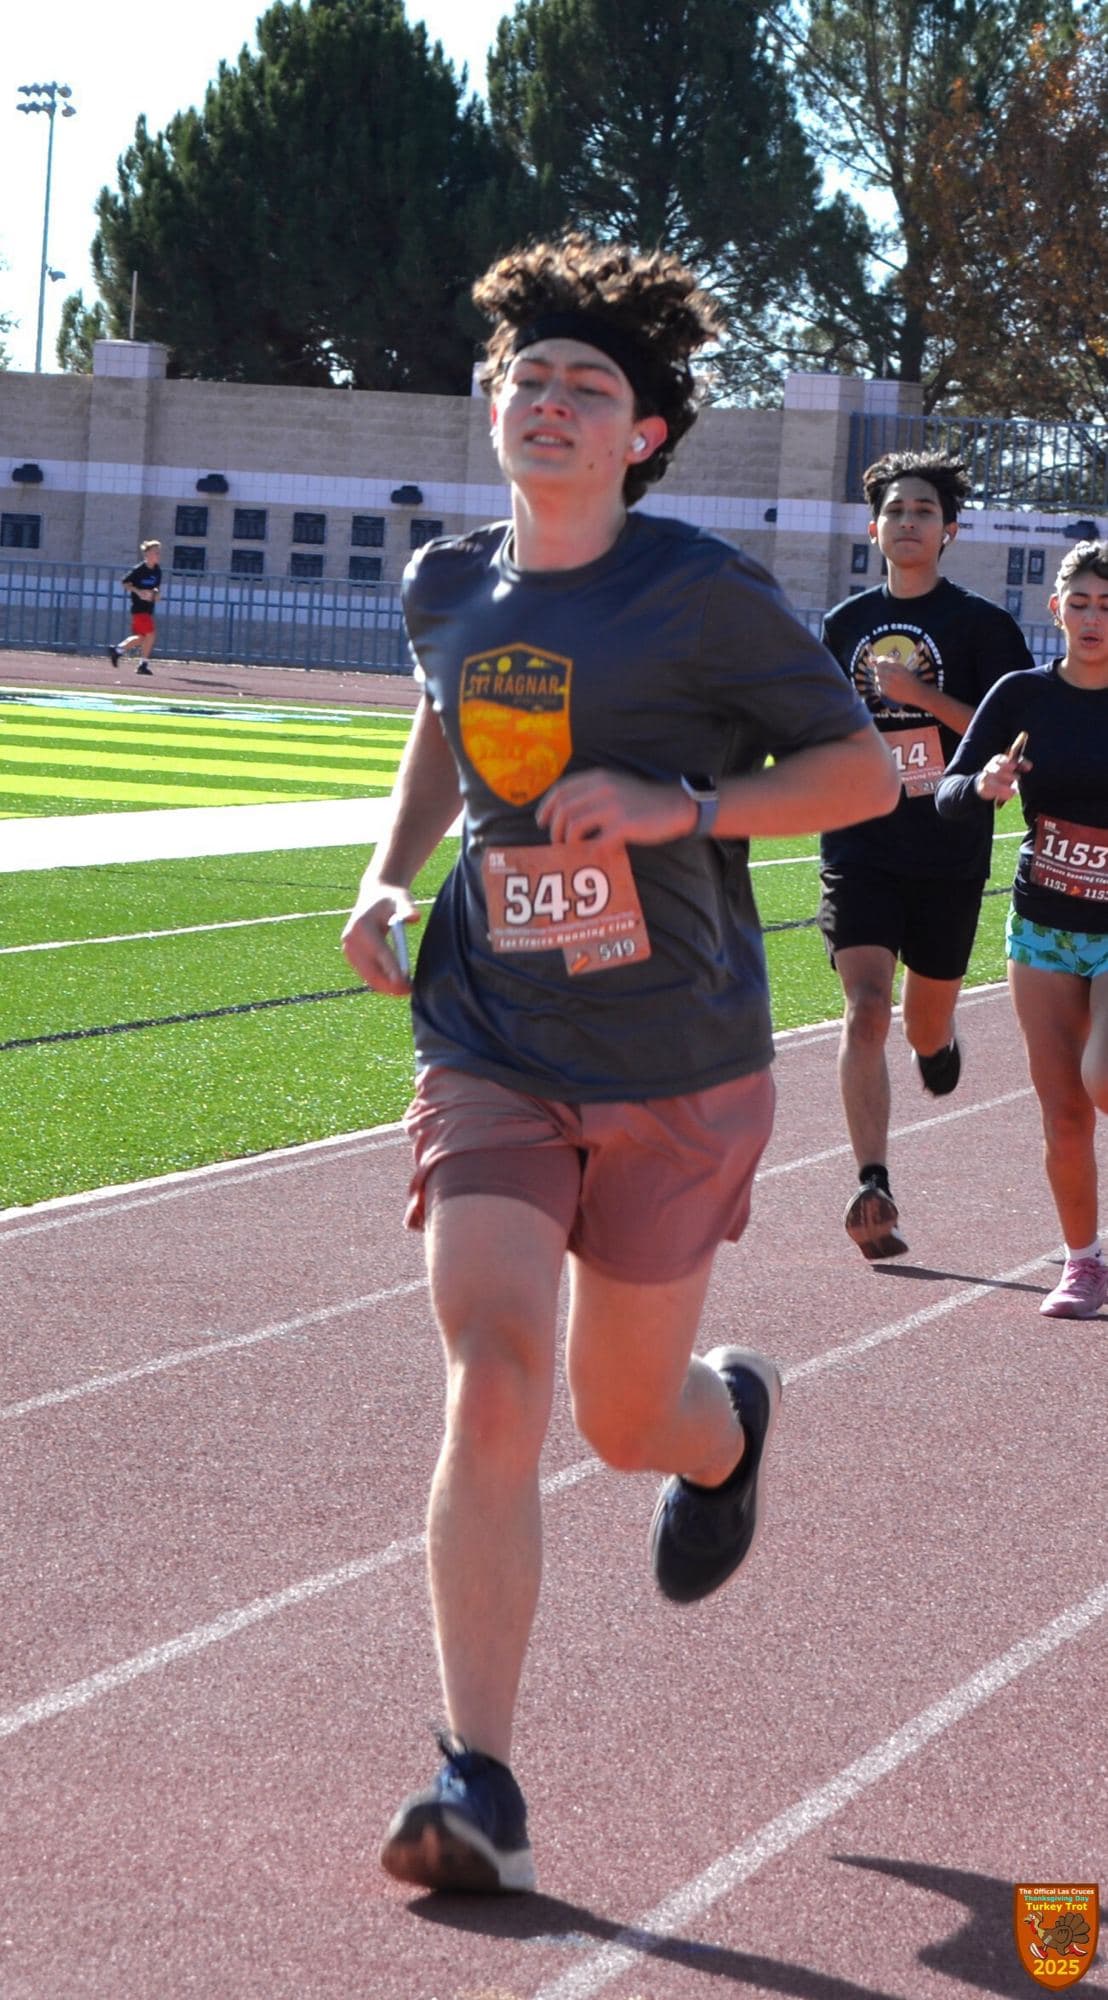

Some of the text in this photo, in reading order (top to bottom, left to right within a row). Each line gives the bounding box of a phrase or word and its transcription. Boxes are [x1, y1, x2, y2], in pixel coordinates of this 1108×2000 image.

[494, 674, 561, 695] RAGNAR
[891, 742, 929, 770] 14
[1041, 834, 1108, 868] 1153
[505, 866, 611, 925] 549
[1043, 876, 1068, 893] 1153
[556, 925, 606, 944] Running
[607, 919, 636, 933] Club
[599, 938, 636, 962] 549
